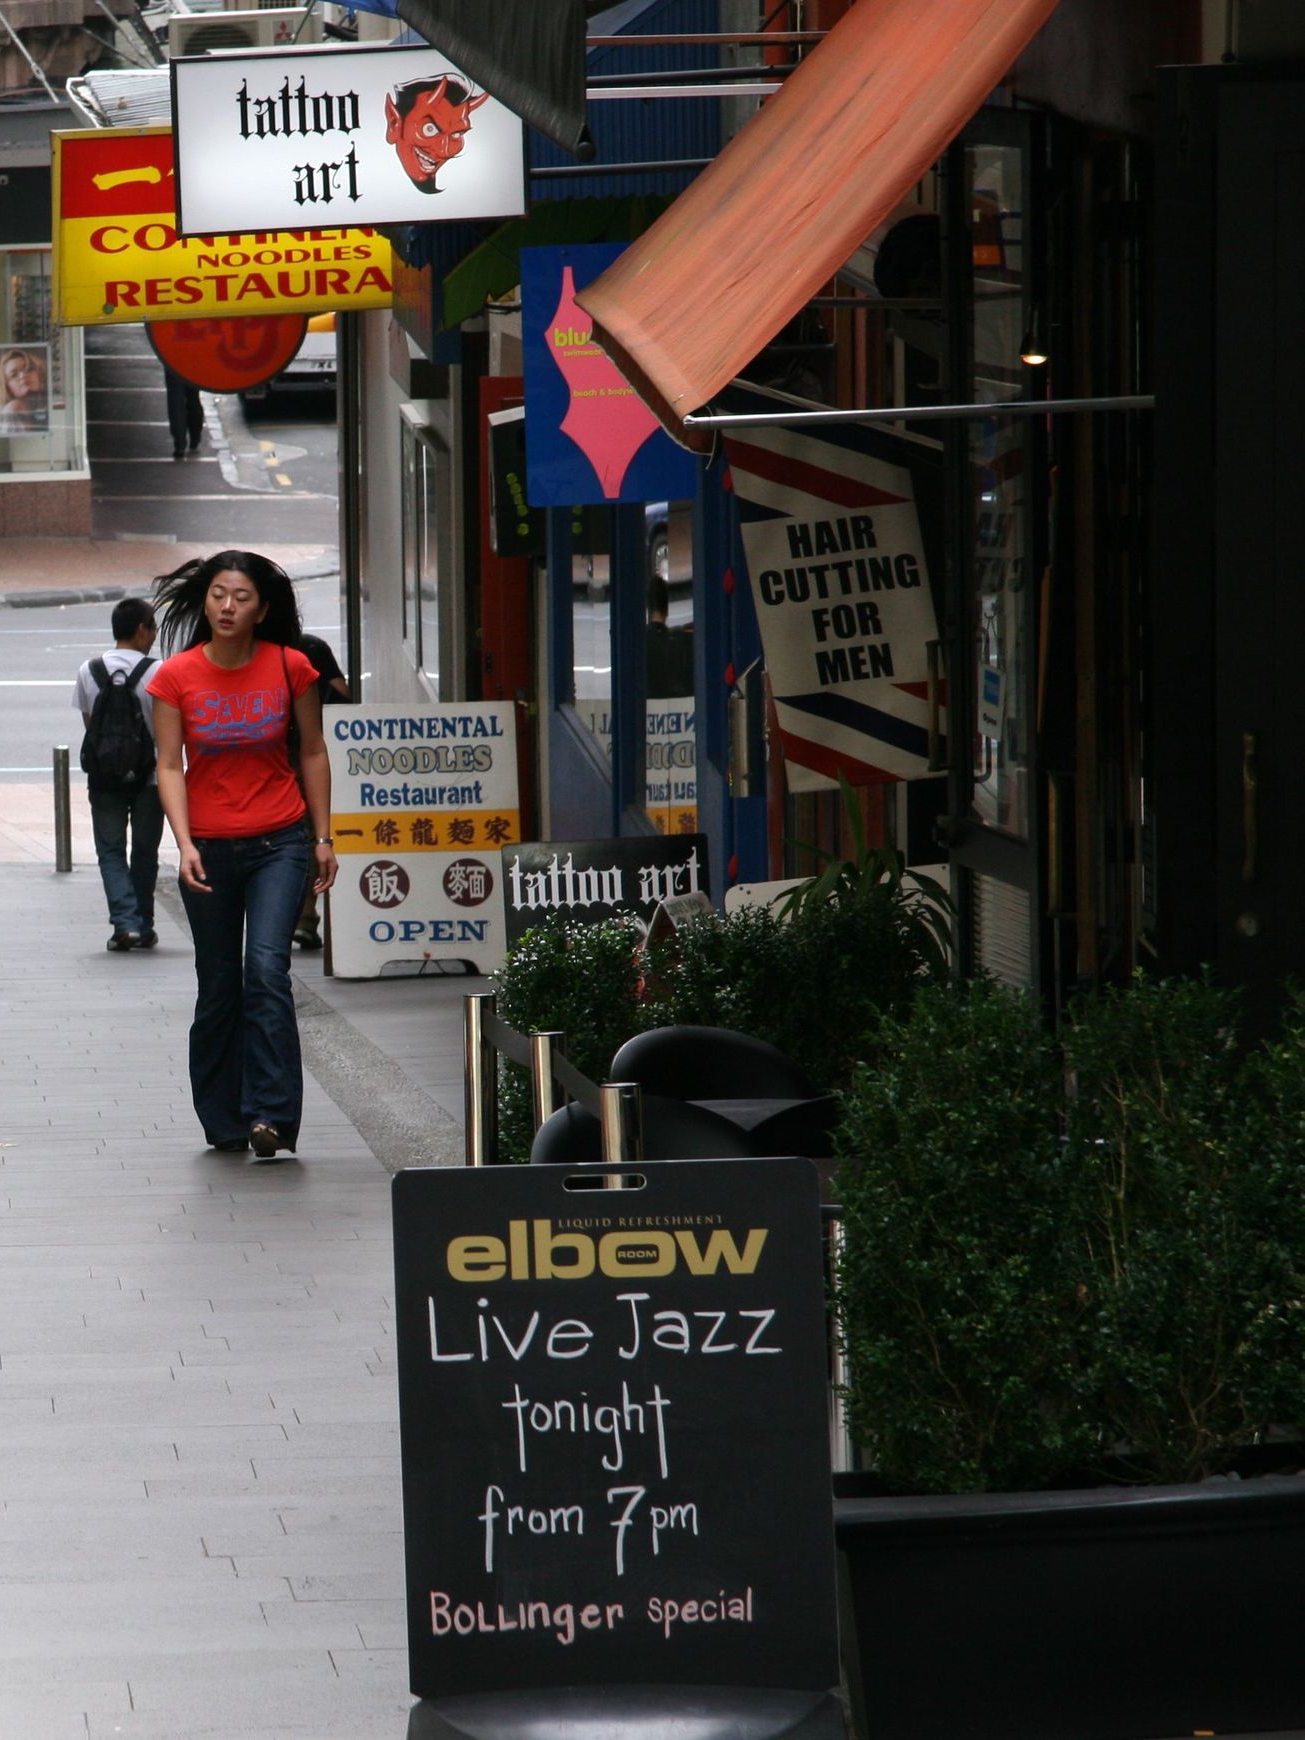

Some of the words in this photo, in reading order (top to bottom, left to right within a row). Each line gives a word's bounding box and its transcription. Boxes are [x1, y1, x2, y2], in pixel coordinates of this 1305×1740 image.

[236, 75, 361, 141] tattoo
[292, 140, 363, 206] art
[197, 245, 372, 269] NOODLES
[554, 327, 591, 347] blu
[786, 515, 877, 559] HAIR
[759, 553, 921, 606] CUTTING
[812, 602, 883, 643] FOR
[815, 643, 894, 686] MEN
[334, 716, 504, 741] CONTINENTAL
[348, 744, 492, 776] NOODLES
[360, 780, 483, 807] Restaurant
[364, 864, 407, 904] 飯
[509, 852, 624, 911] tattoo
[638, 846, 701, 904] art
[369, 920, 488, 943] OPEN
[558, 1218, 612, 1230] LIQUID
[619, 1214, 724, 1228] REFRESHMENT
[447, 1219, 769, 1282] elbow
[617, 1249, 657, 1259] ROOM
[428, 1296, 594, 1362] Live
[615, 1293, 783, 1360] Jazz
[501, 1381, 671, 1479] tonight
[478, 1485, 584, 1573] from
[647, 1586, 753, 1639] special
